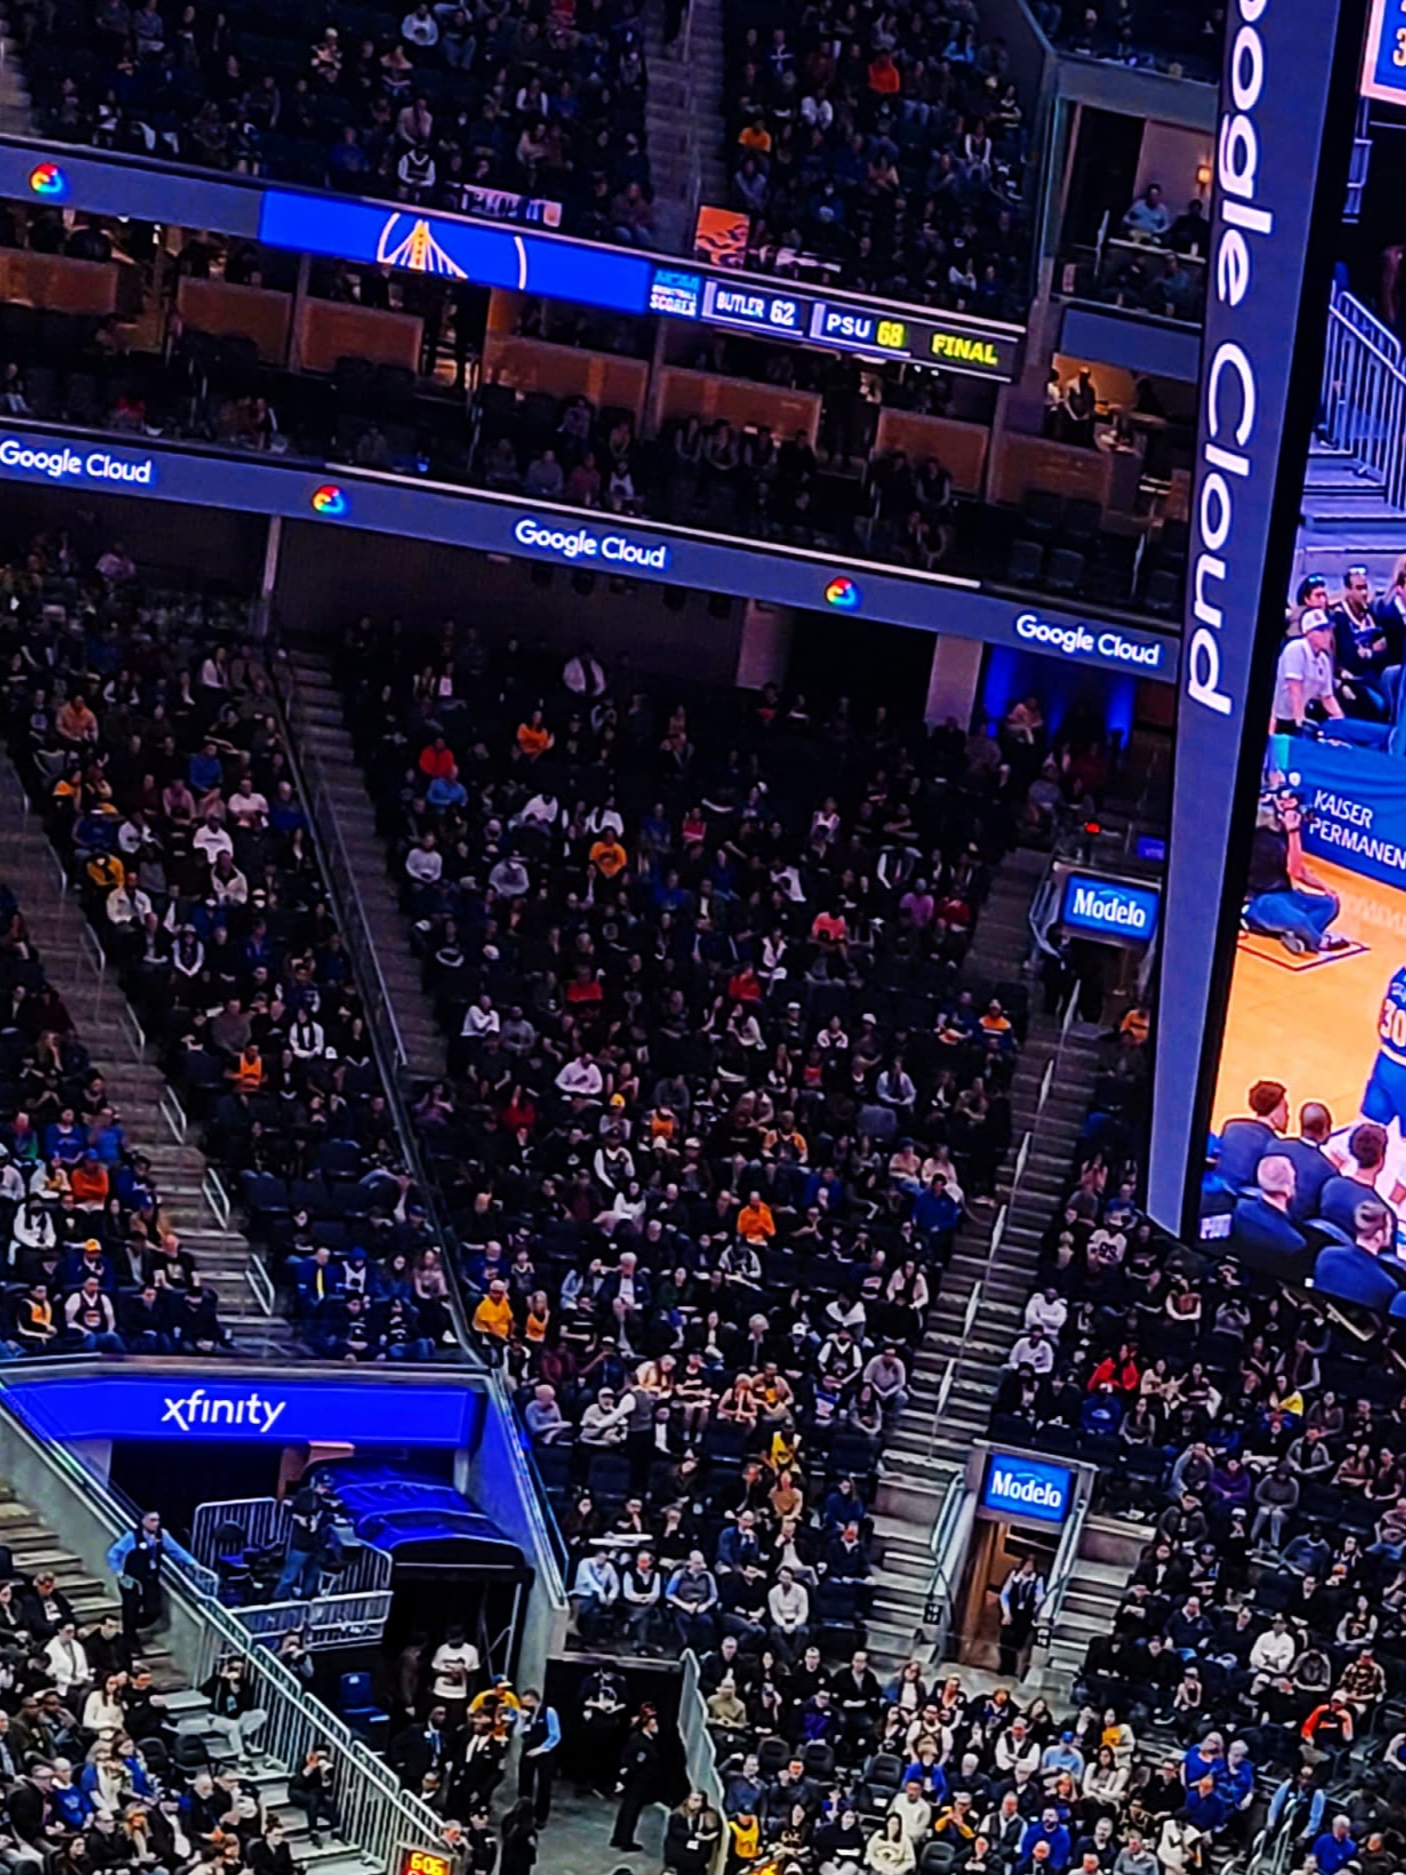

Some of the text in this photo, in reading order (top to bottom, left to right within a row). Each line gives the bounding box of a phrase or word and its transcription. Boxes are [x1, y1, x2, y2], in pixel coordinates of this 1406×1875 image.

[716, 291, 765, 319] BUTLER
[770, 300, 796, 327] 62
[826, 313, 872, 338] PSU
[876, 320, 905, 348] 68
[931, 334, 998, 366] FINAL
[1187, 0, 1274, 716] ogle Cloud
[0, 440, 152, 483] Google Cloud
[514, 519, 667, 569] Google Cloud
[1016, 614, 1161, 666] Google Cloud
[1313, 788, 1374, 830] KAISER
[1072, 887, 1147, 929] Modelo
[161, 1388, 287, 1433] xfinity
[990, 1469, 1062, 1508] Modelo
